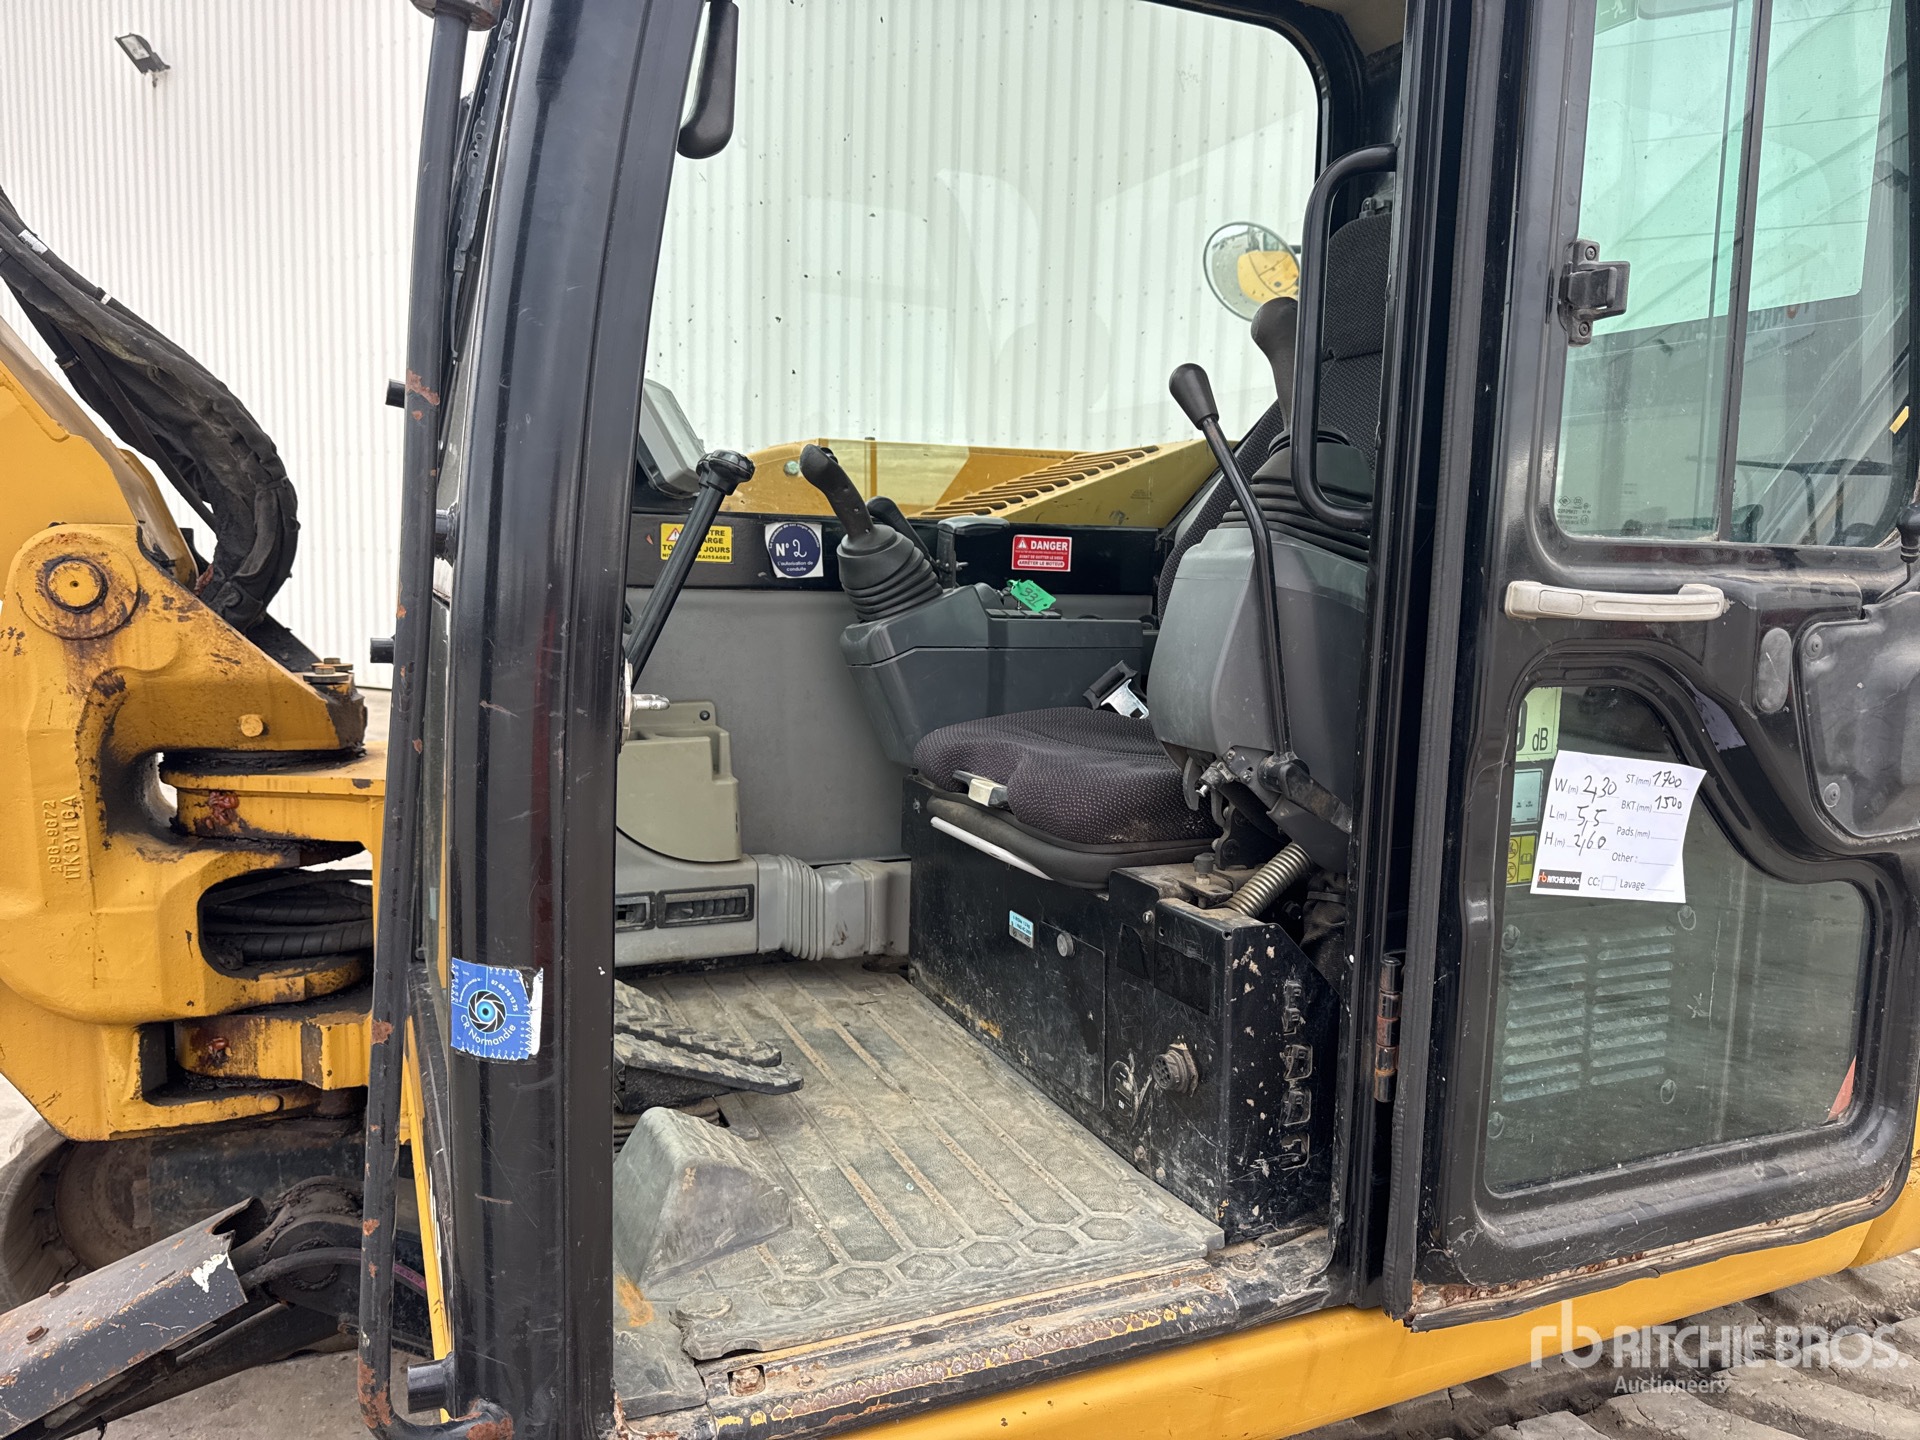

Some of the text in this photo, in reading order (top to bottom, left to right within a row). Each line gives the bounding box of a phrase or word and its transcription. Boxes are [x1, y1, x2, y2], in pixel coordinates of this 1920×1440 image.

[792, 538, 808, 558] 2
[1030, 540, 1068, 551] DANGER
[1532, 727, 1549, 751] dB
[1652, 770, 1682, 788] 1700
[1655, 795, 1682, 810] 1500
[42, 800, 64, 873] 296-9672
[1619, 879, 1645, 891] Lavage
[461, 1014, 470, 1029] CR
[468, 1024, 516, 1046] Normandie
